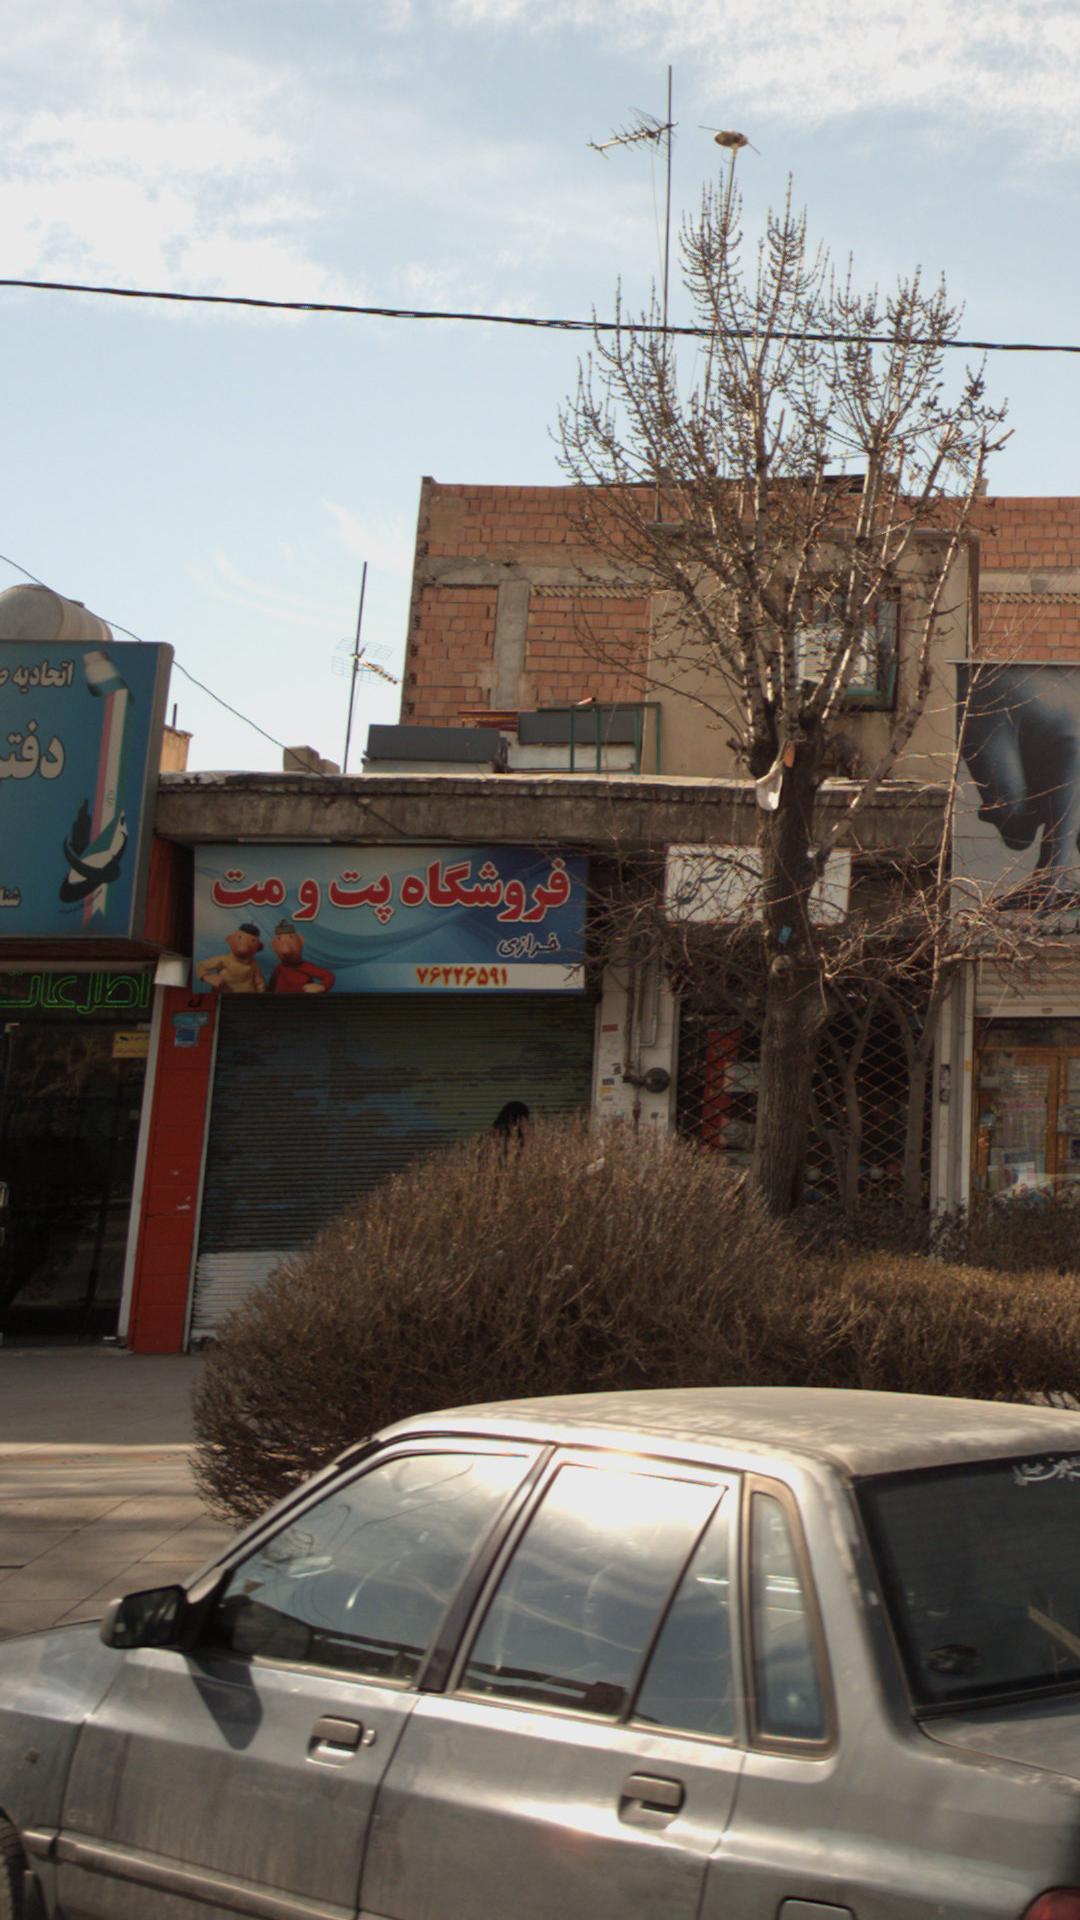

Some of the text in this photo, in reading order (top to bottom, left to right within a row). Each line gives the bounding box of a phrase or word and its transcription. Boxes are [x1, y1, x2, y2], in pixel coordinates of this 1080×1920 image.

[12, 661, 75, 694] اتحادیه
[0, 719, 65, 779] دفت
[212, 858, 570, 923] فروشگاه پت و مت
[497, 932, 560, 958] خرازی
